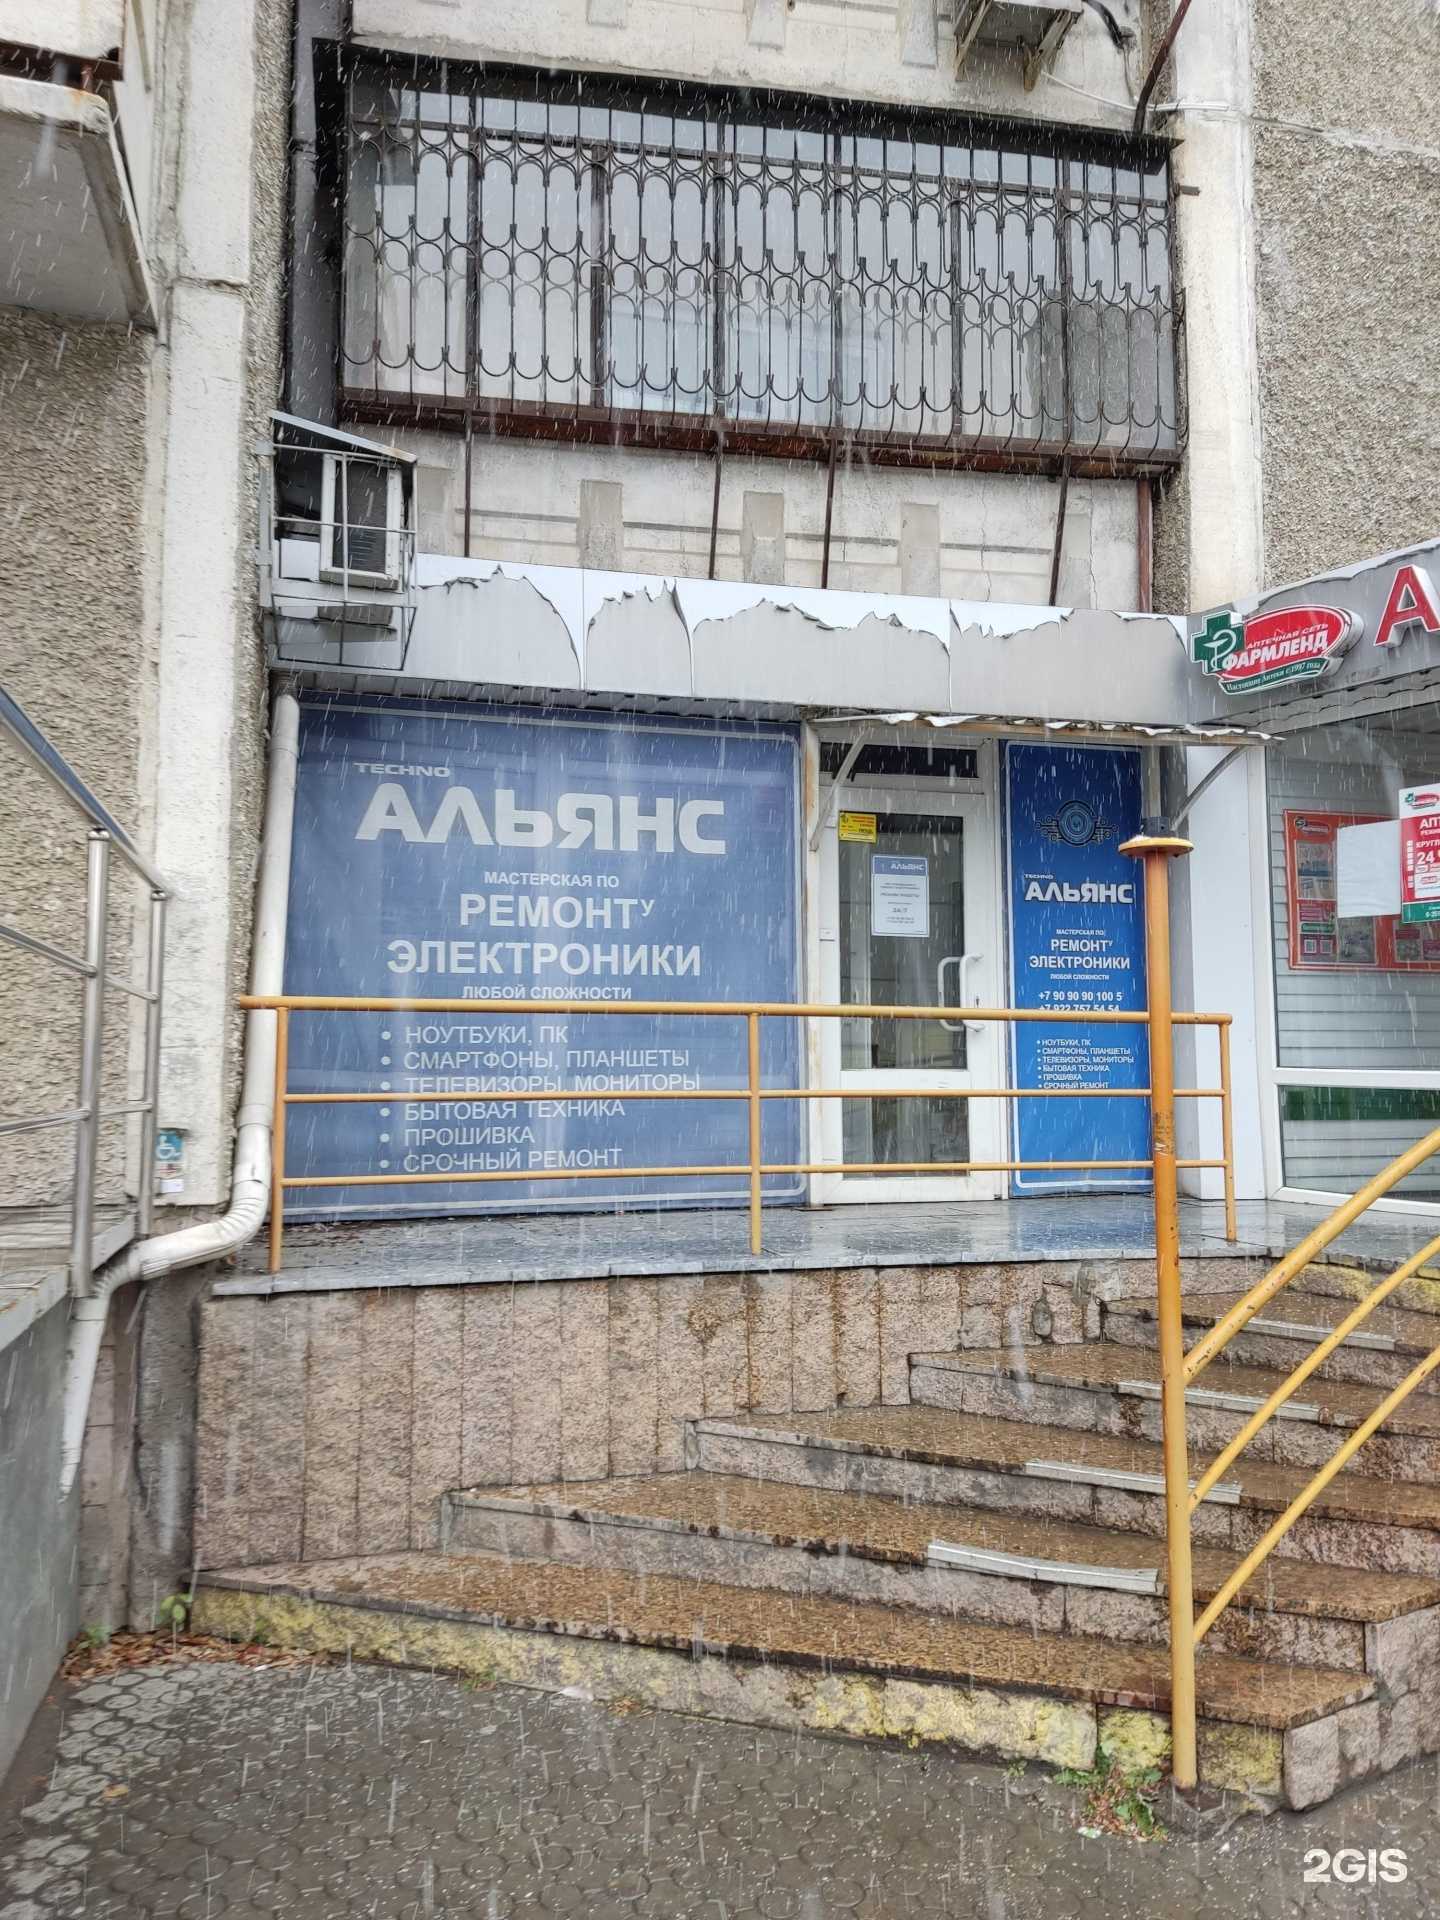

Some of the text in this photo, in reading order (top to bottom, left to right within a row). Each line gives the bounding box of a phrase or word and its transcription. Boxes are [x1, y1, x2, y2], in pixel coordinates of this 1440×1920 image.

[1246, 623, 1329, 650] АПТЕЧНАЯ СЕТЬ
[1221, 630, 1329, 671] ФАРМЛЕНД
[353, 762, 451, 778] TECHNO
[355, 783, 726, 855] АЛЬЯНС
[1416, 851, 1435, 865] 24
[484, 871, 620, 889] МАСТЕРСКАЯ ПО
[1025, 880, 1134, 904] АЛЬЯНС
[386, 939, 701, 977] ЭЛЕКТРОНИКИ
[1029, 955, 1131, 969] ЭЛЕКТРОНИКИ
[462, 983, 632, 1000] ЛЮБОЙ СЛОЖНОСТИ
[1039, 991, 1123, 1001] +7 90 90 90 100 5
[405, 1026, 569, 1046] НОУТБУКИ, ПК
[404, 1050, 690, 1071] СМАРТФОНЫ, ПЛАНШЕТЫ
[575, 1073, 701, 1092] МОНИТОРЫ
[1043, 1081, 1079, 1089] СРОЧНЫЙ
[404, 1099, 626, 1121] БЫТОВАЯ ТЕХНИКА
[404, 1126, 536, 1147] ПРОШИВКА
[404, 1148, 623, 1172] СРОЧНЫЙ РЕМОНТ
